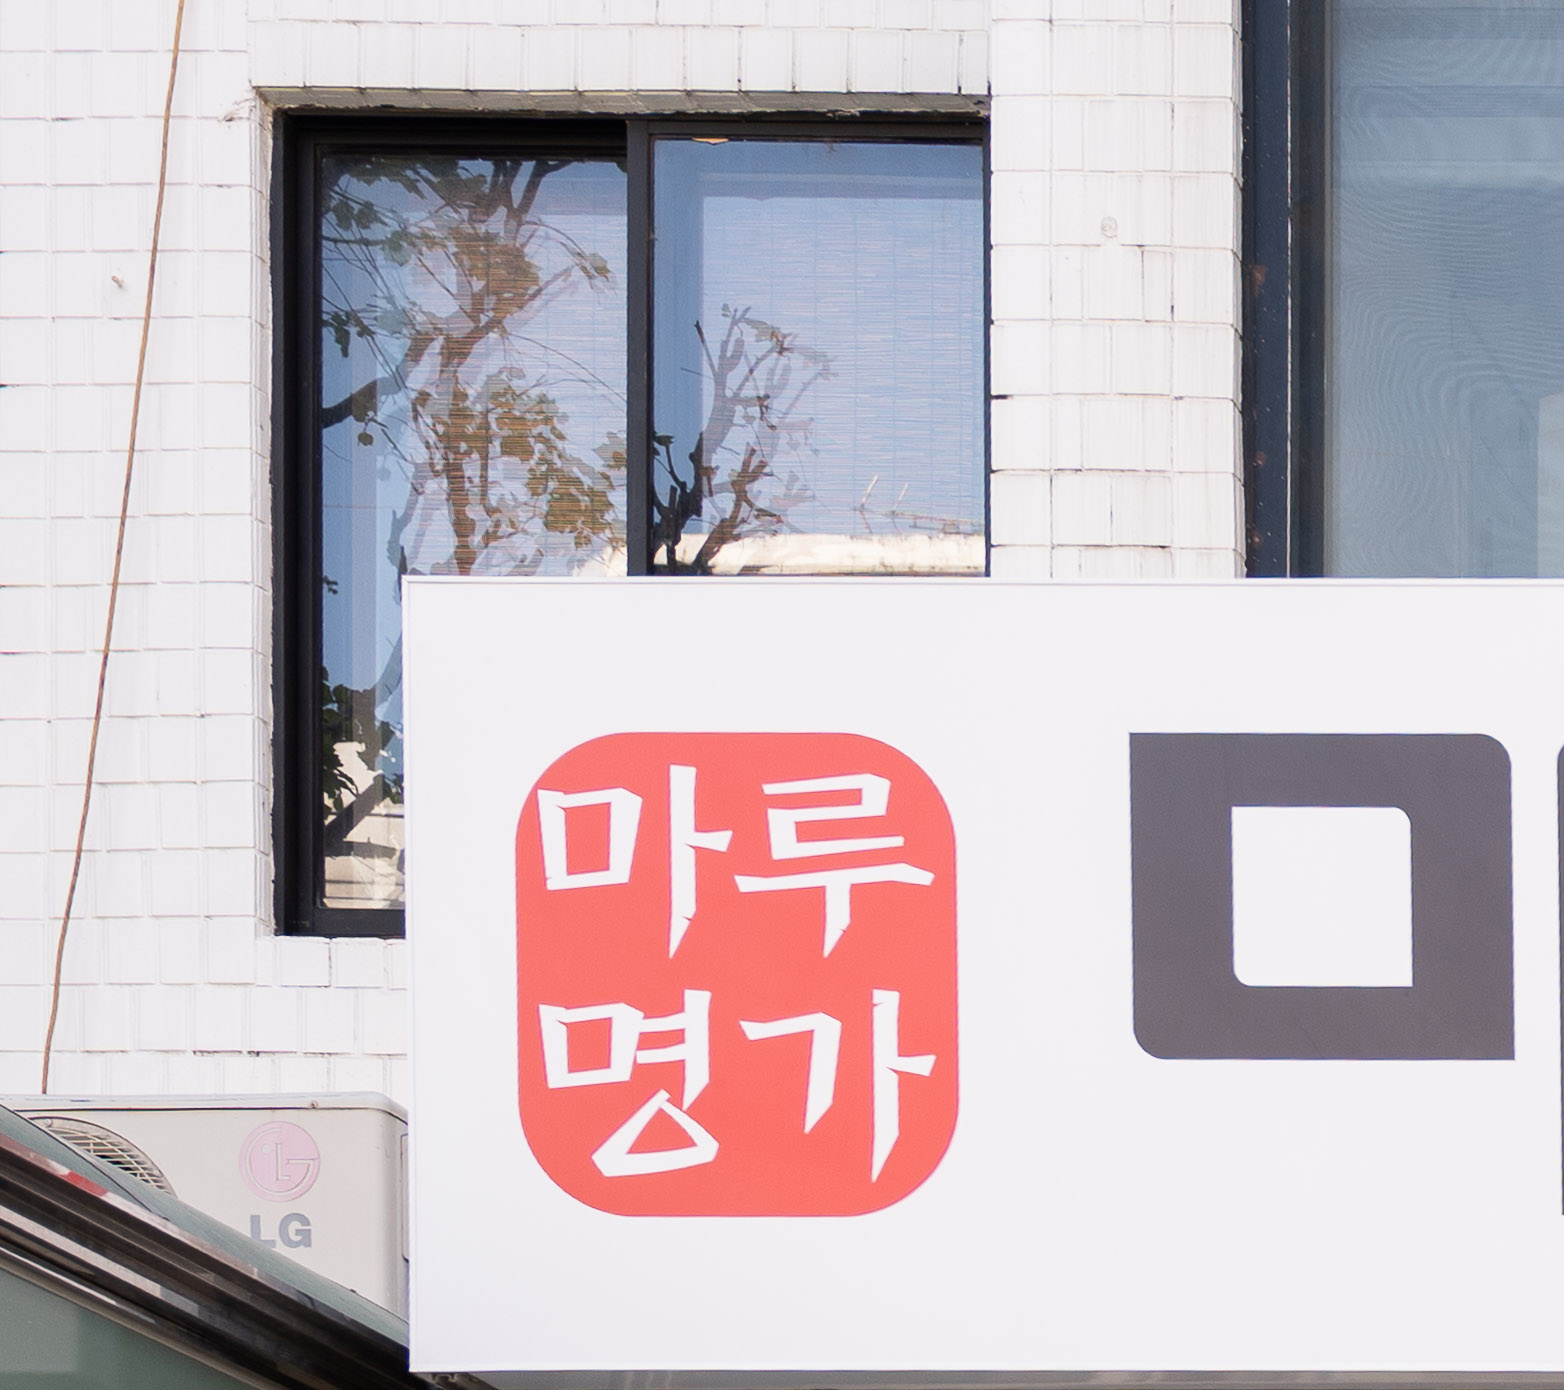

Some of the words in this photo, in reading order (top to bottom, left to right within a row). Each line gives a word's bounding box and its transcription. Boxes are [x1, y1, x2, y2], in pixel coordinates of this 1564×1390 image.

[537, 764, 935, 959] 마루
[538, 988, 937, 1184] 명가
[250, 1212, 312, 1249] LG
